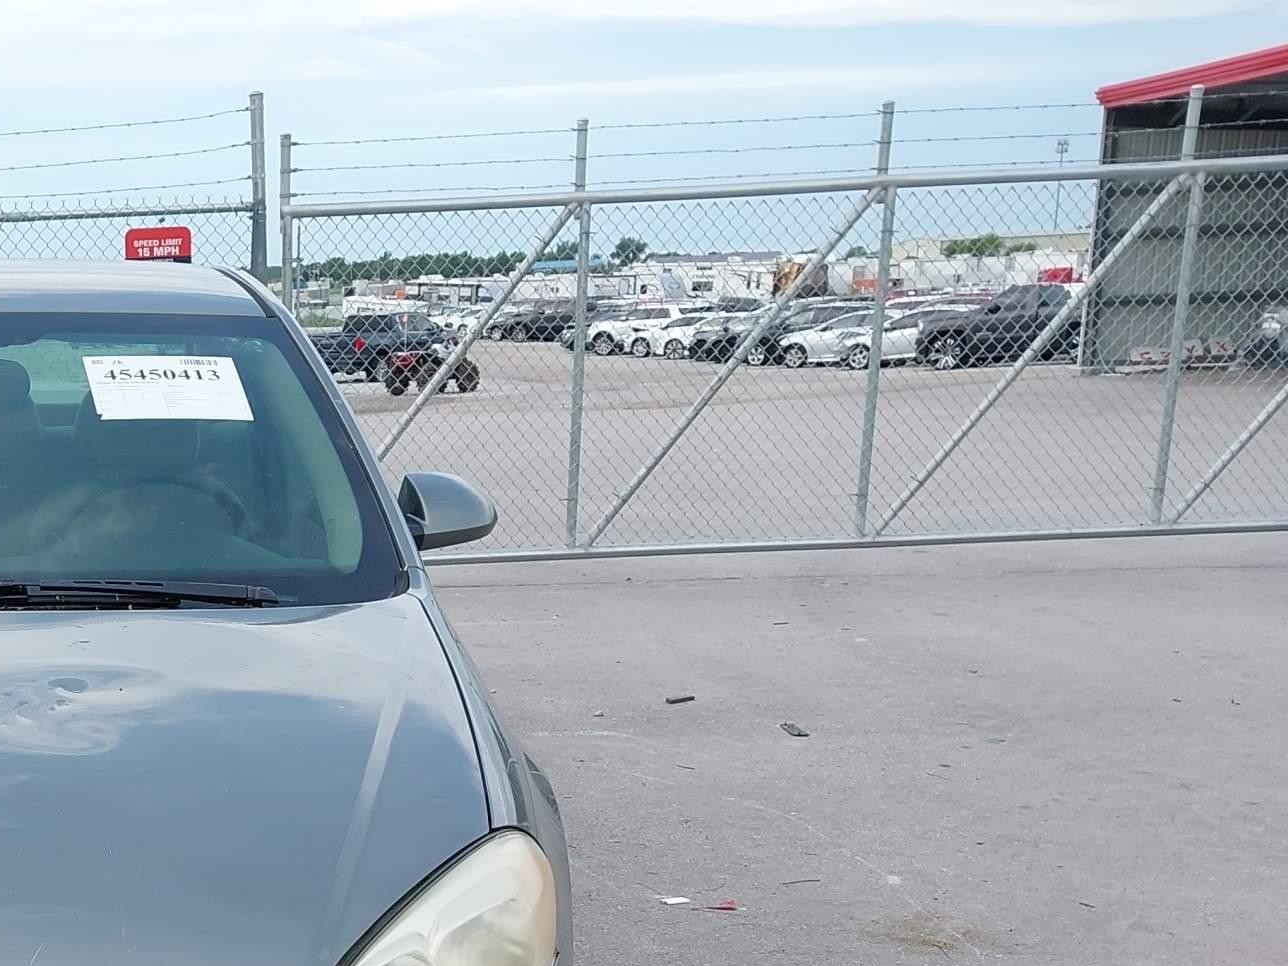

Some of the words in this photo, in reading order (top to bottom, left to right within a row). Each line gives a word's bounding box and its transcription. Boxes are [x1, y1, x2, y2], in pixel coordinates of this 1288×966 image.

[133, 239, 159, 247] SPEED
[161, 238, 183, 246] LIMIT
[137, 247, 150, 257] 15
[153, 246, 180, 256] MPH
[103, 368, 221, 381] 45450413
